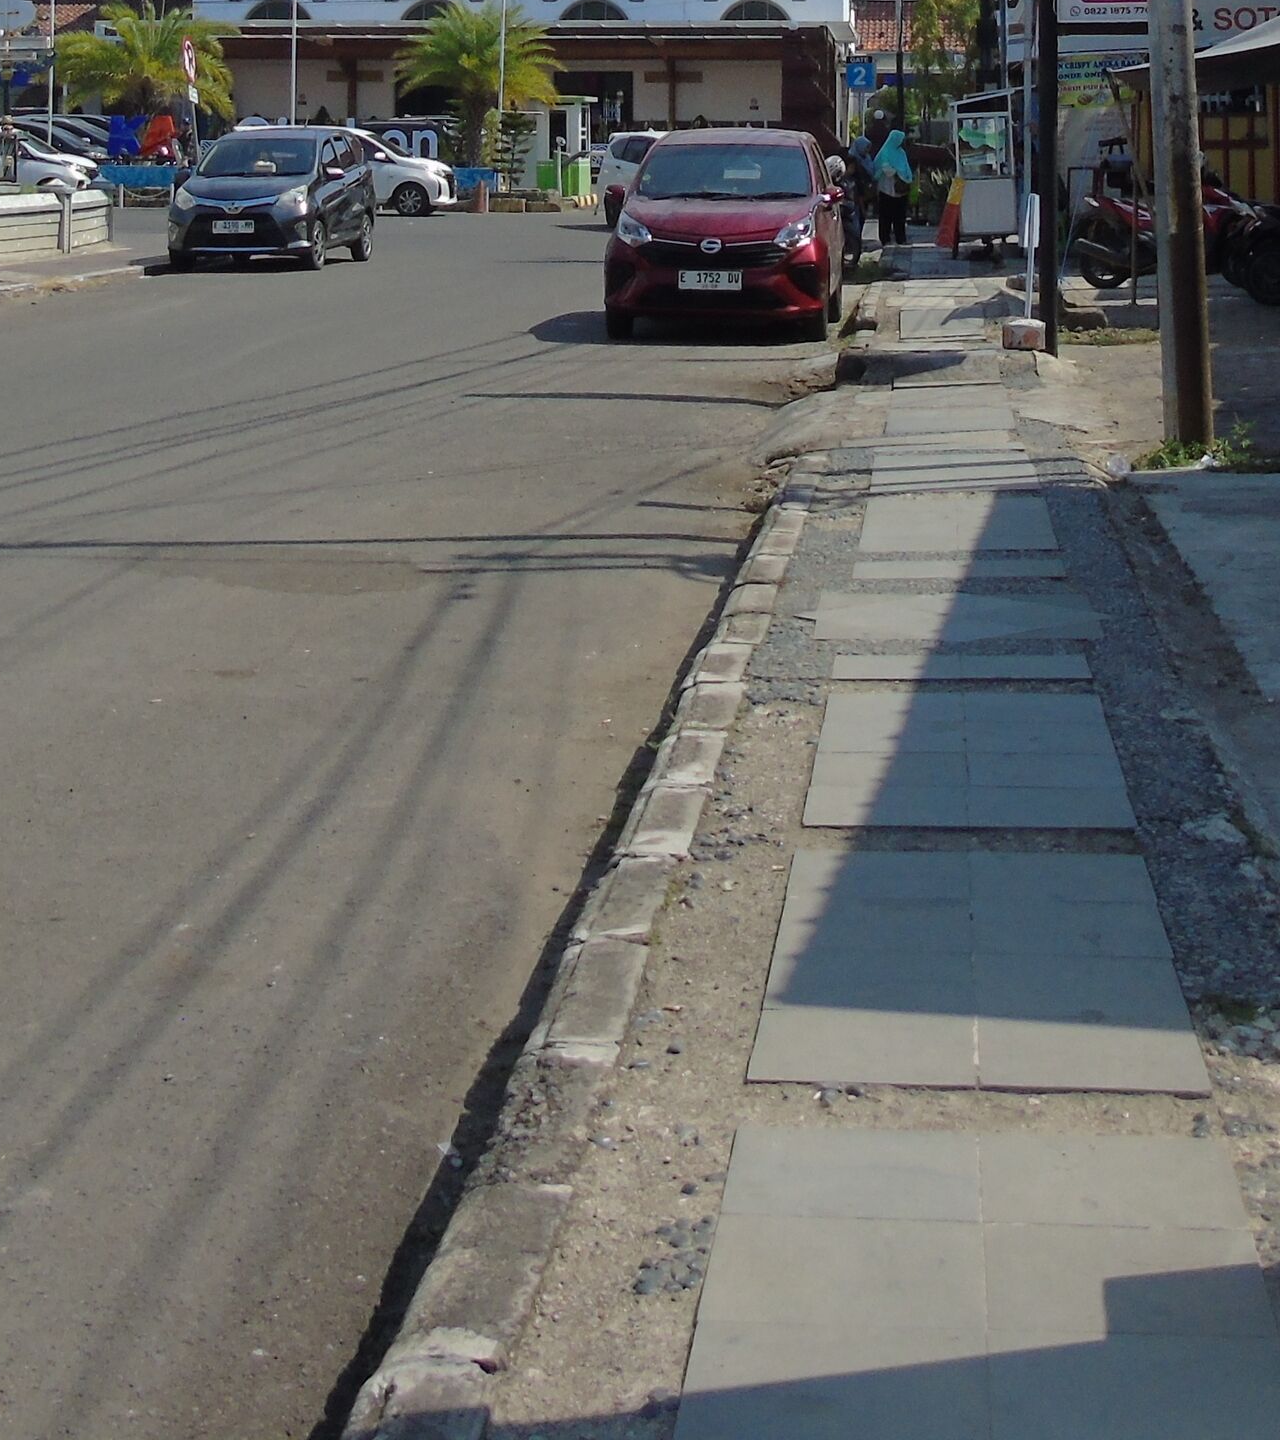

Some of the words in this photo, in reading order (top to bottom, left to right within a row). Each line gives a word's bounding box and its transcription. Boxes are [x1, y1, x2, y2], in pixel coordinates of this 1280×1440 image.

[853, 66, 867, 85] 2
[680, 271, 686, 283] E
[696, 272, 721, 283] 1752
